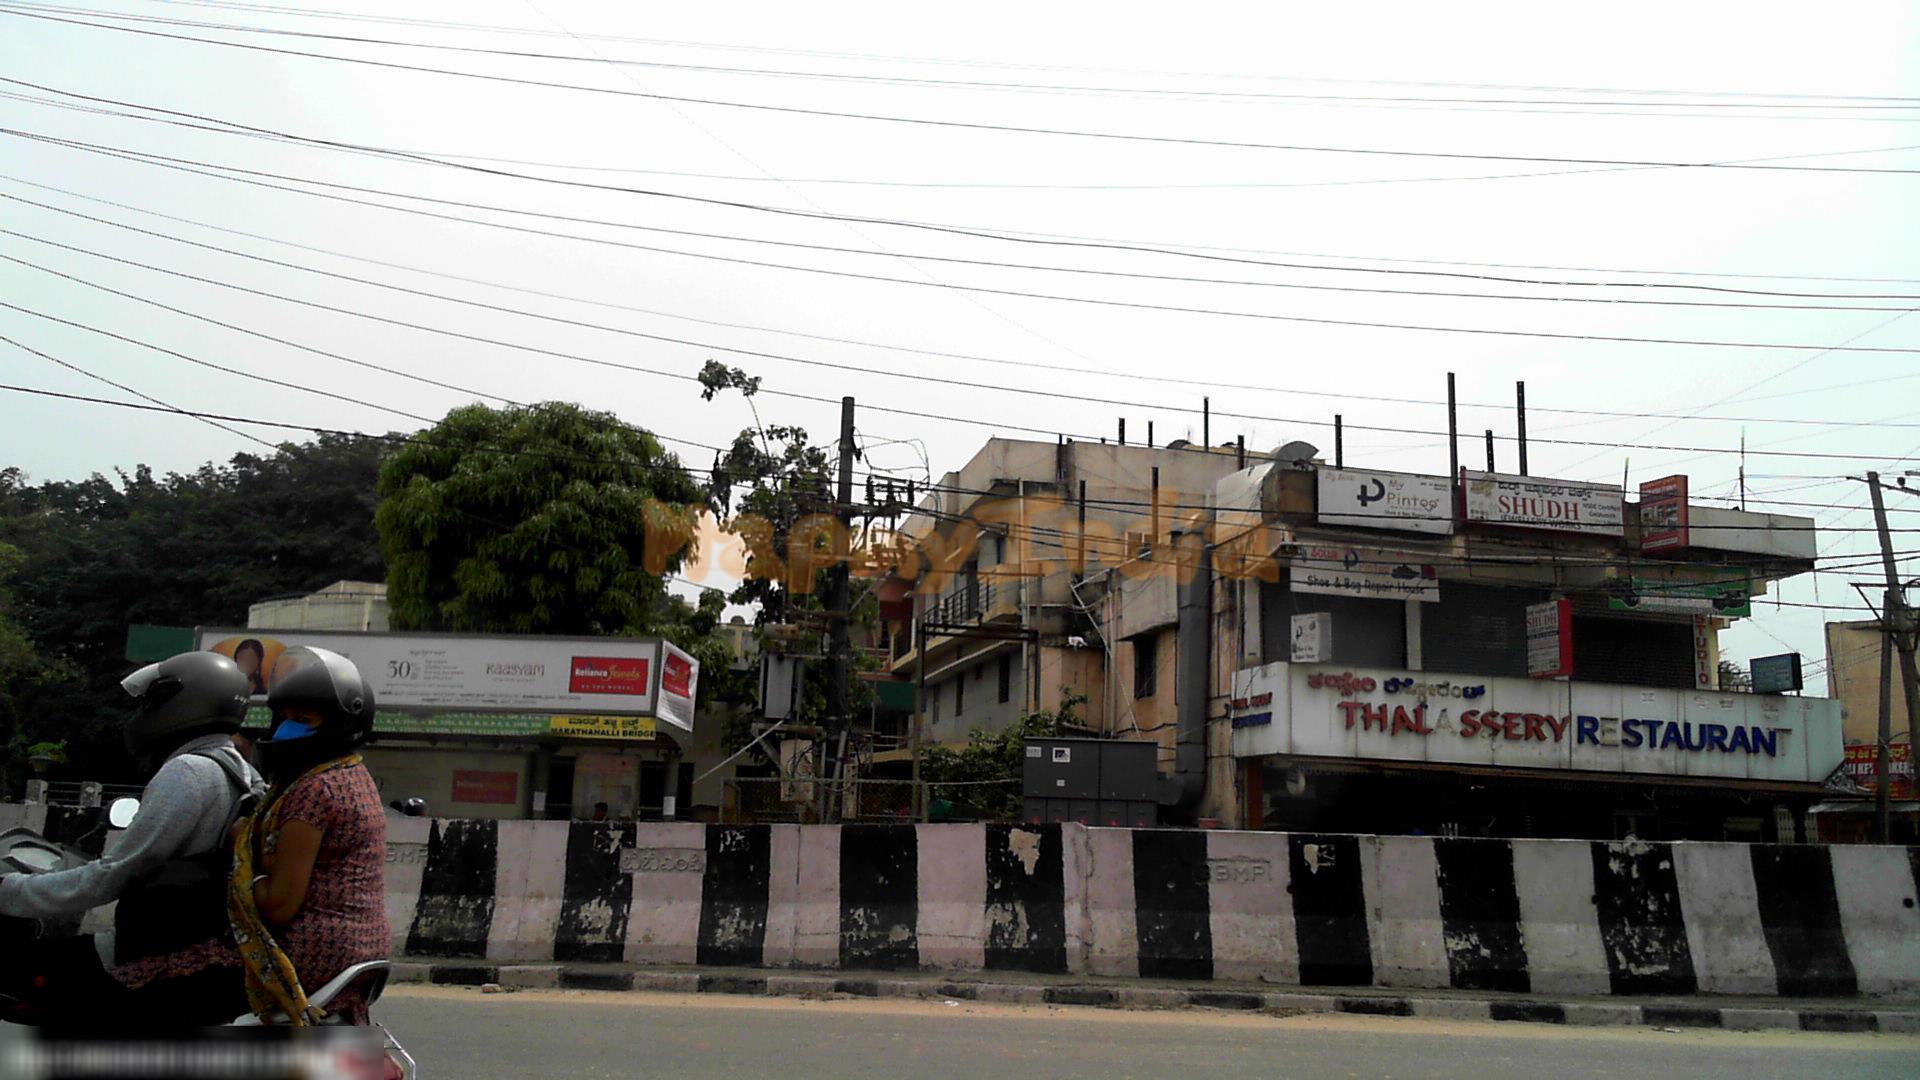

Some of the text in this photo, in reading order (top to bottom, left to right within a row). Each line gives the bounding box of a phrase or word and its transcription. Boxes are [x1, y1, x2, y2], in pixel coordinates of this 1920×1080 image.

[1498, 495, 1579, 520] SHUDH
[1307, 575, 1424, 595] Shoe & Bag Repair House
[1527, 612, 1557, 627] SHUDH
[576, 667, 608, 678] Reliance
[622, 729, 655, 738] BRIDGE
[1337, 702, 1792, 757] THALASSERY RESTAURANT
